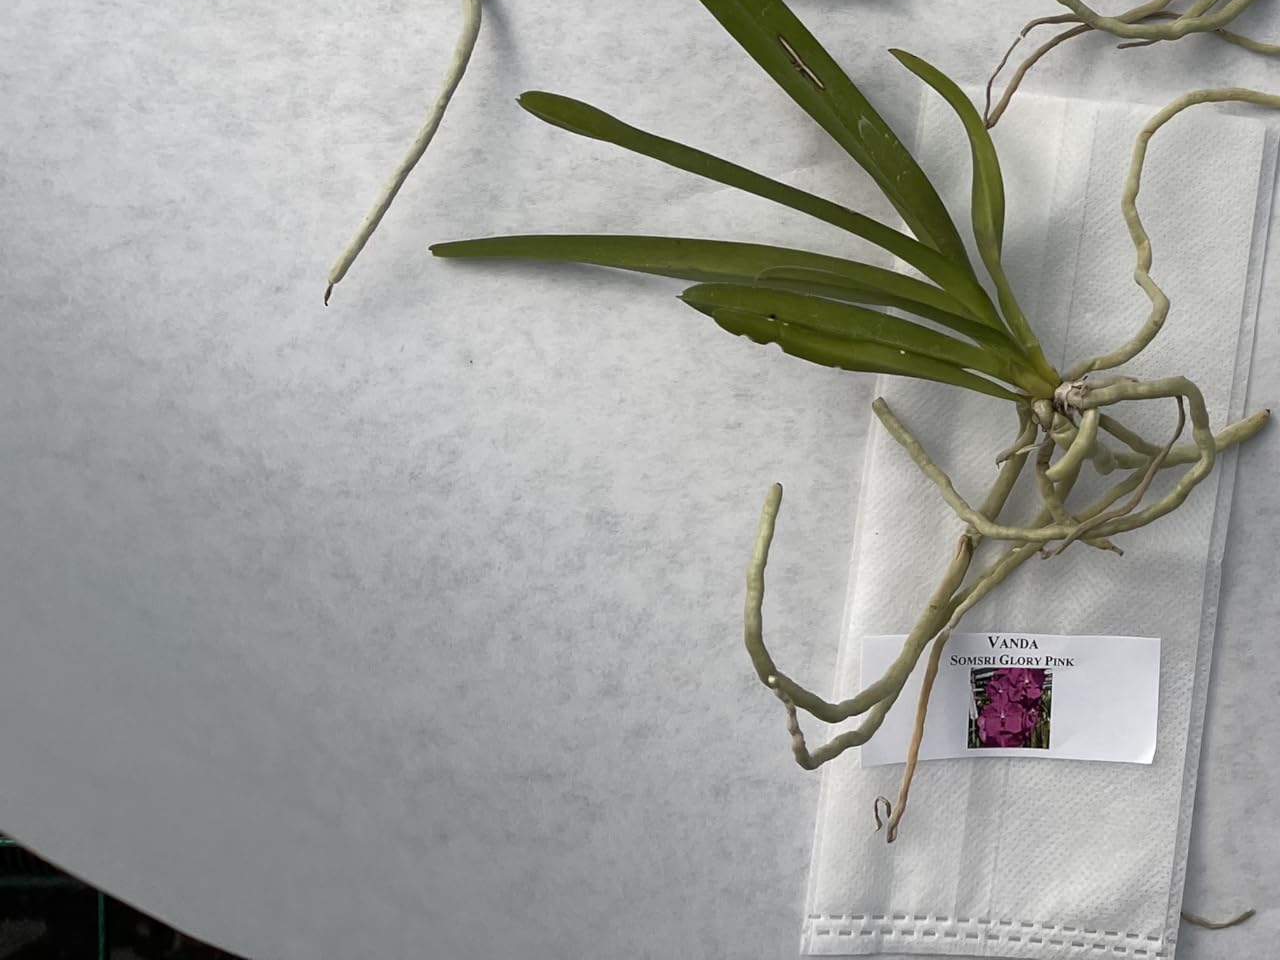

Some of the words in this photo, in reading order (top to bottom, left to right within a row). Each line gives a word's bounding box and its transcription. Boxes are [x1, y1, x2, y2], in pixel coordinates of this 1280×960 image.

[988, 636, 1039, 650] VANDA
[950, 655, 996, 666] SOMSRI
[999, 654, 1042, 667] GLORY
[1045, 656, 1075, 667] PINK
